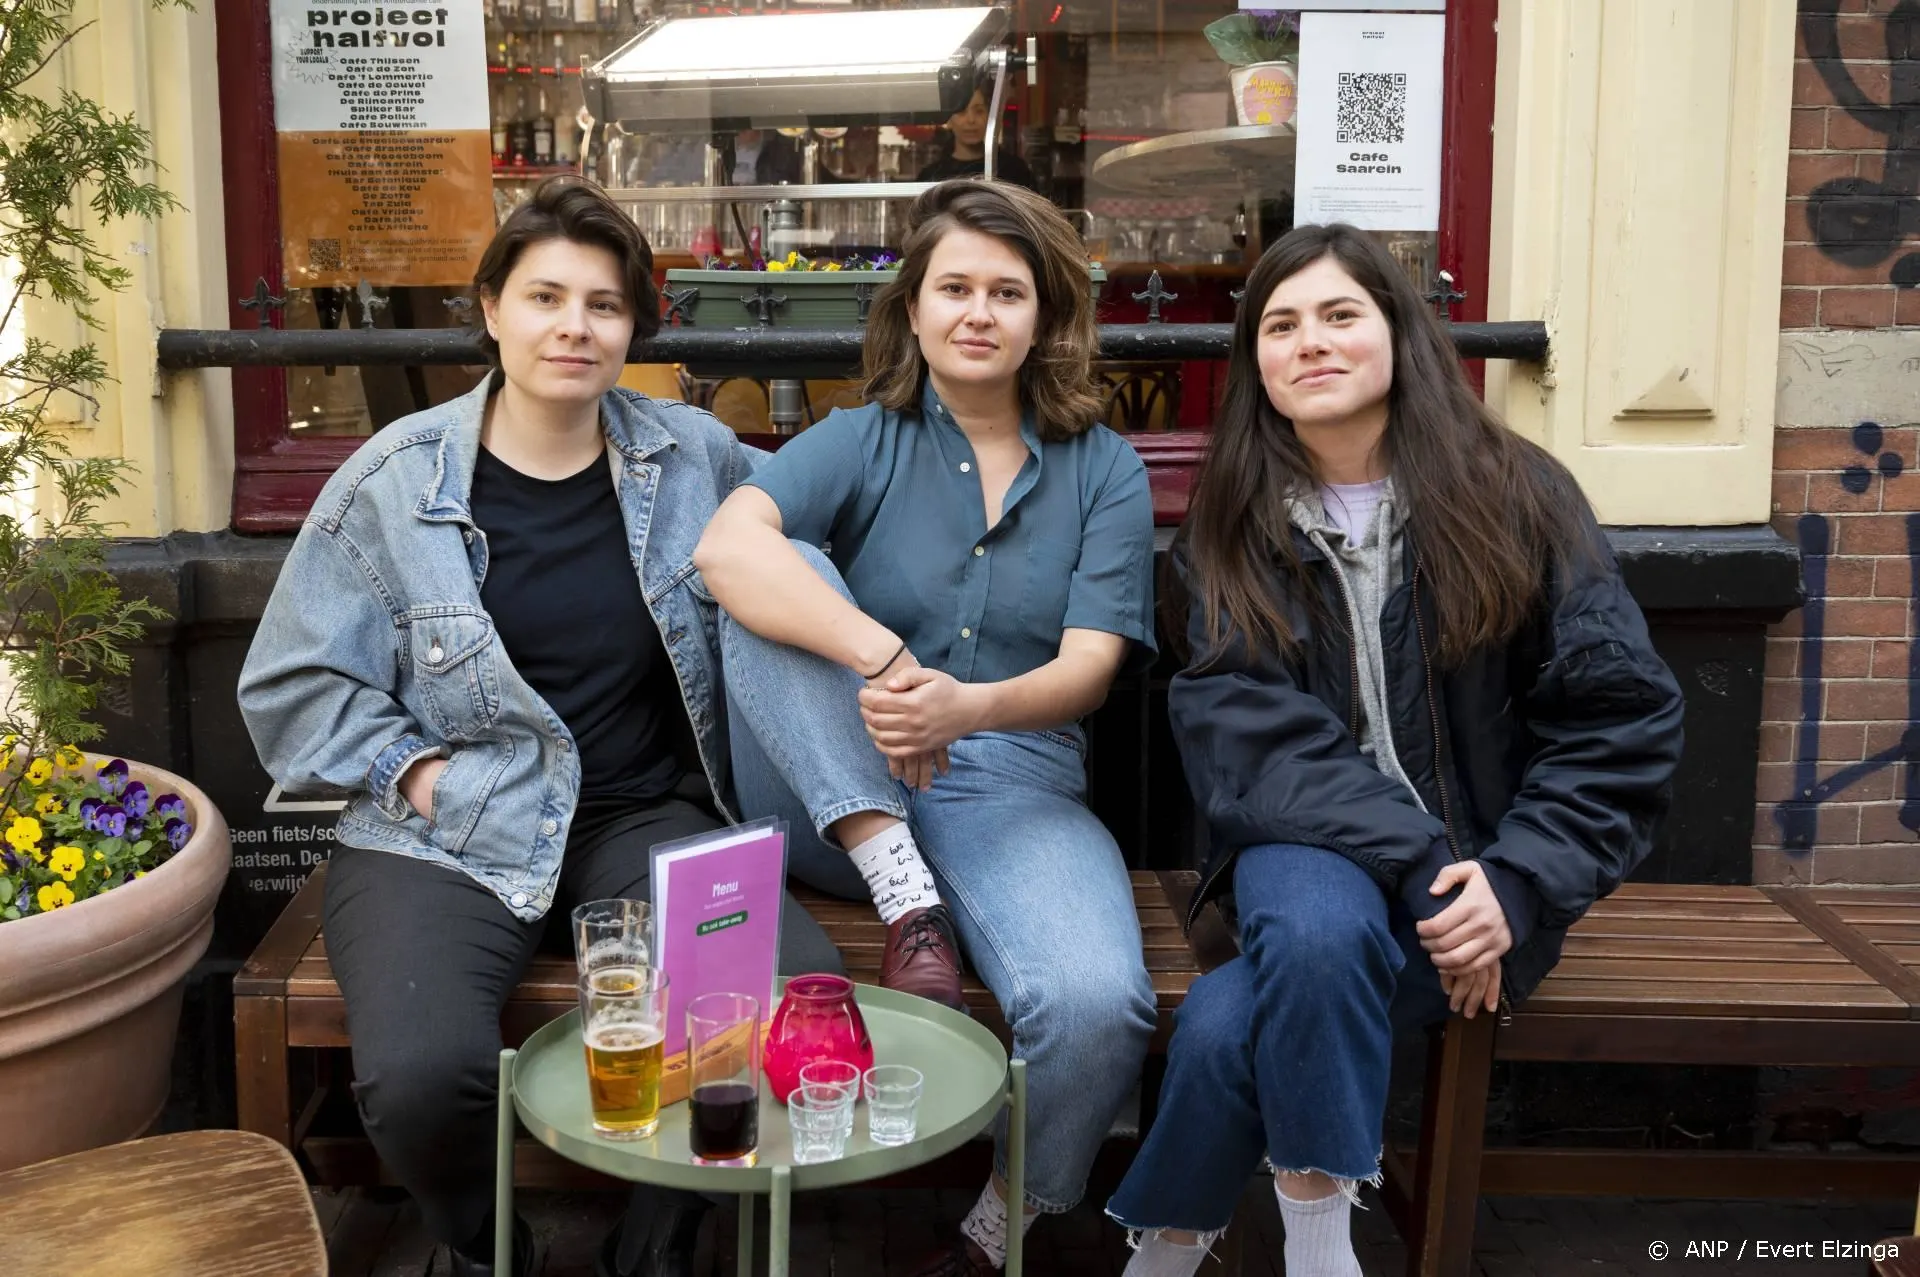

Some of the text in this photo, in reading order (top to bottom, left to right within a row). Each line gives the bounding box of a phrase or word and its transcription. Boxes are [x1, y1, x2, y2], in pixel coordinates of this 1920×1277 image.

[307, 8, 448, 26] project
[314, 30, 445, 47] halfvol
[1350, 152, 1388, 162] Cafe
[1336, 164, 1401, 173] Saarein
[228, 829, 267, 843] Geen
[231, 850, 322, 868] aatsen. De
[712, 881, 738, 897] Menu
